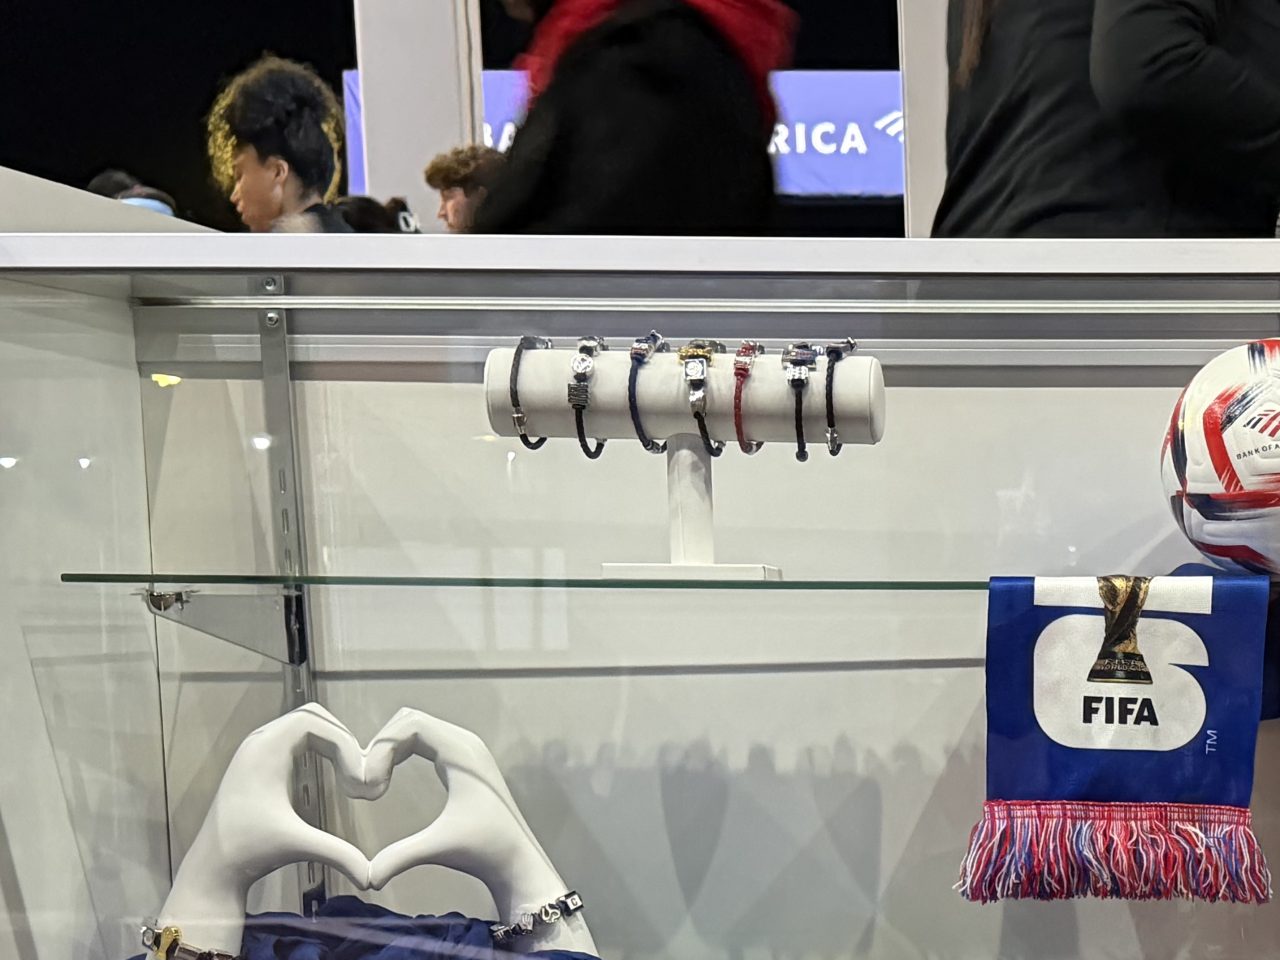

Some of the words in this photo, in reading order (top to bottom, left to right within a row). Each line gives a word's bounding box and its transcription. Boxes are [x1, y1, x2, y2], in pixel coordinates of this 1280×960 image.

[767, 122, 868, 154] RICA
[1236, 448, 1260, 460] BANK
[1261, 444, 1273, 452] OF
[1083, 696, 1159, 726] FIFA
[1206, 729, 1218, 755] TM
